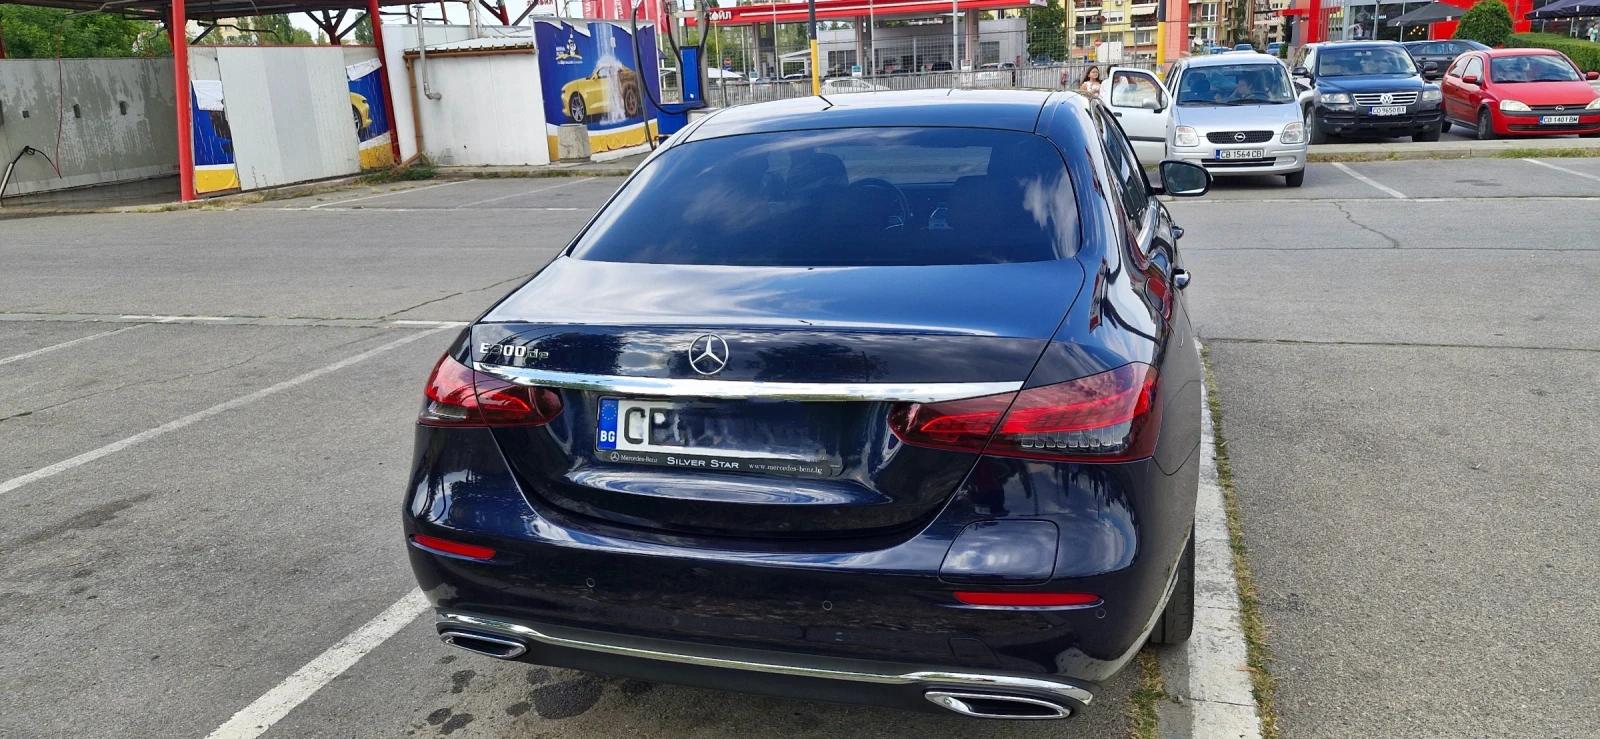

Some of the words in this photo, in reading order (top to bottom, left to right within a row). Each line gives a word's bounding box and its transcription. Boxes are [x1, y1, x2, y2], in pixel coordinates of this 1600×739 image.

[600, 430, 616, 442] BG
[620, 454, 659, 463] Mercedes-Benz
[667, 456, 706, 467] SILVER
[710, 459, 740, 469] STAR
